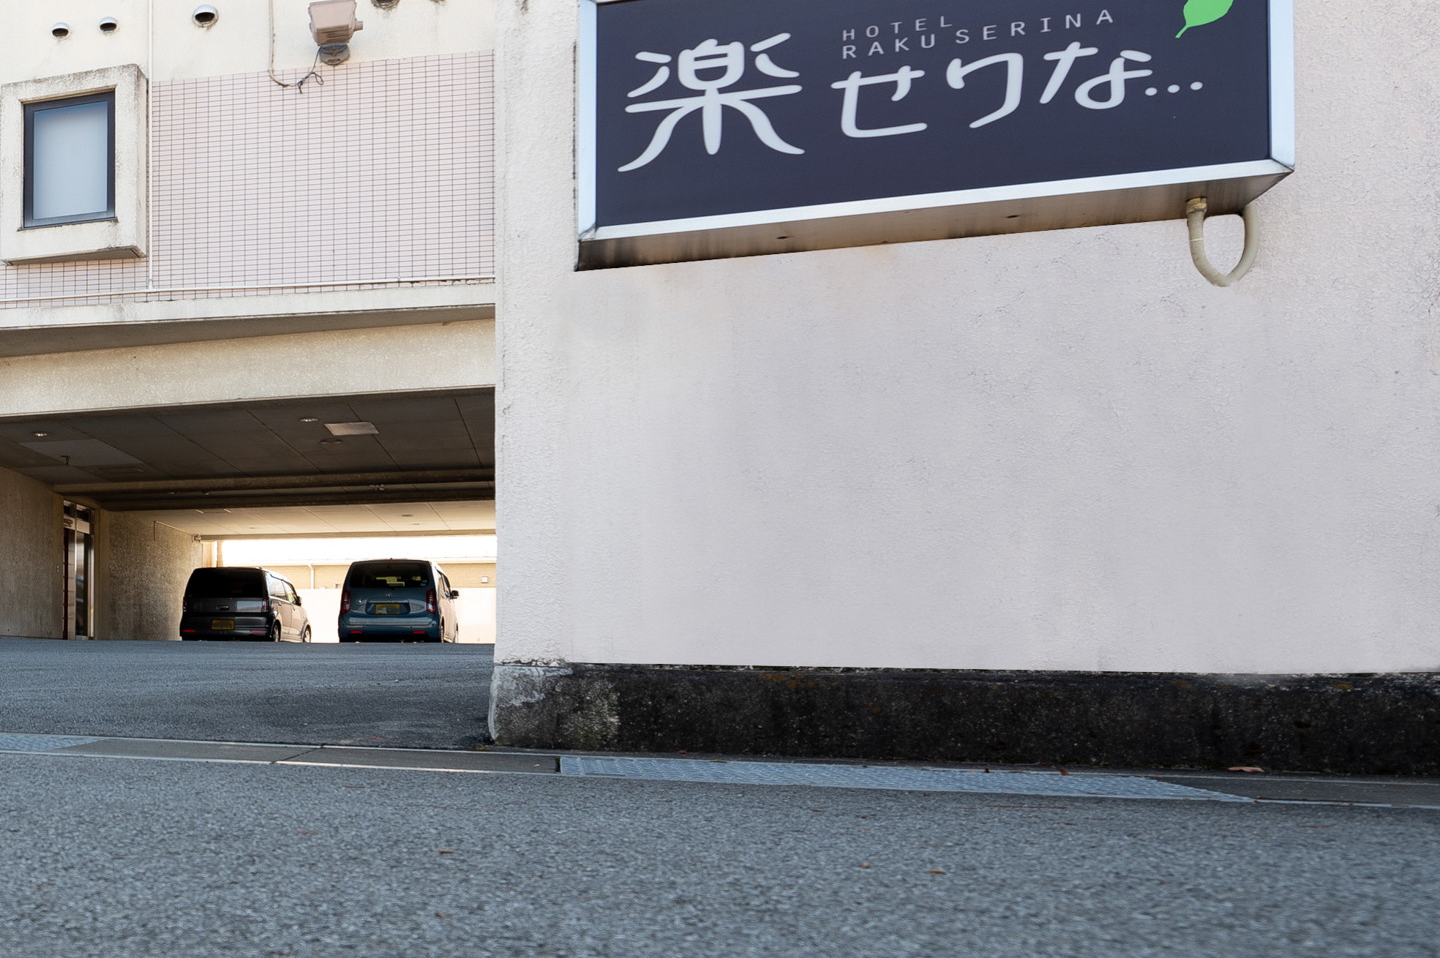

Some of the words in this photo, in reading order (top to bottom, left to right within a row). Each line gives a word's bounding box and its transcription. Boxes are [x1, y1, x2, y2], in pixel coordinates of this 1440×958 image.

[841, 33, 937, 59] RAKU
[956, 9, 1114, 45] SERINA
[842, 15, 953, 41] HOTEL
